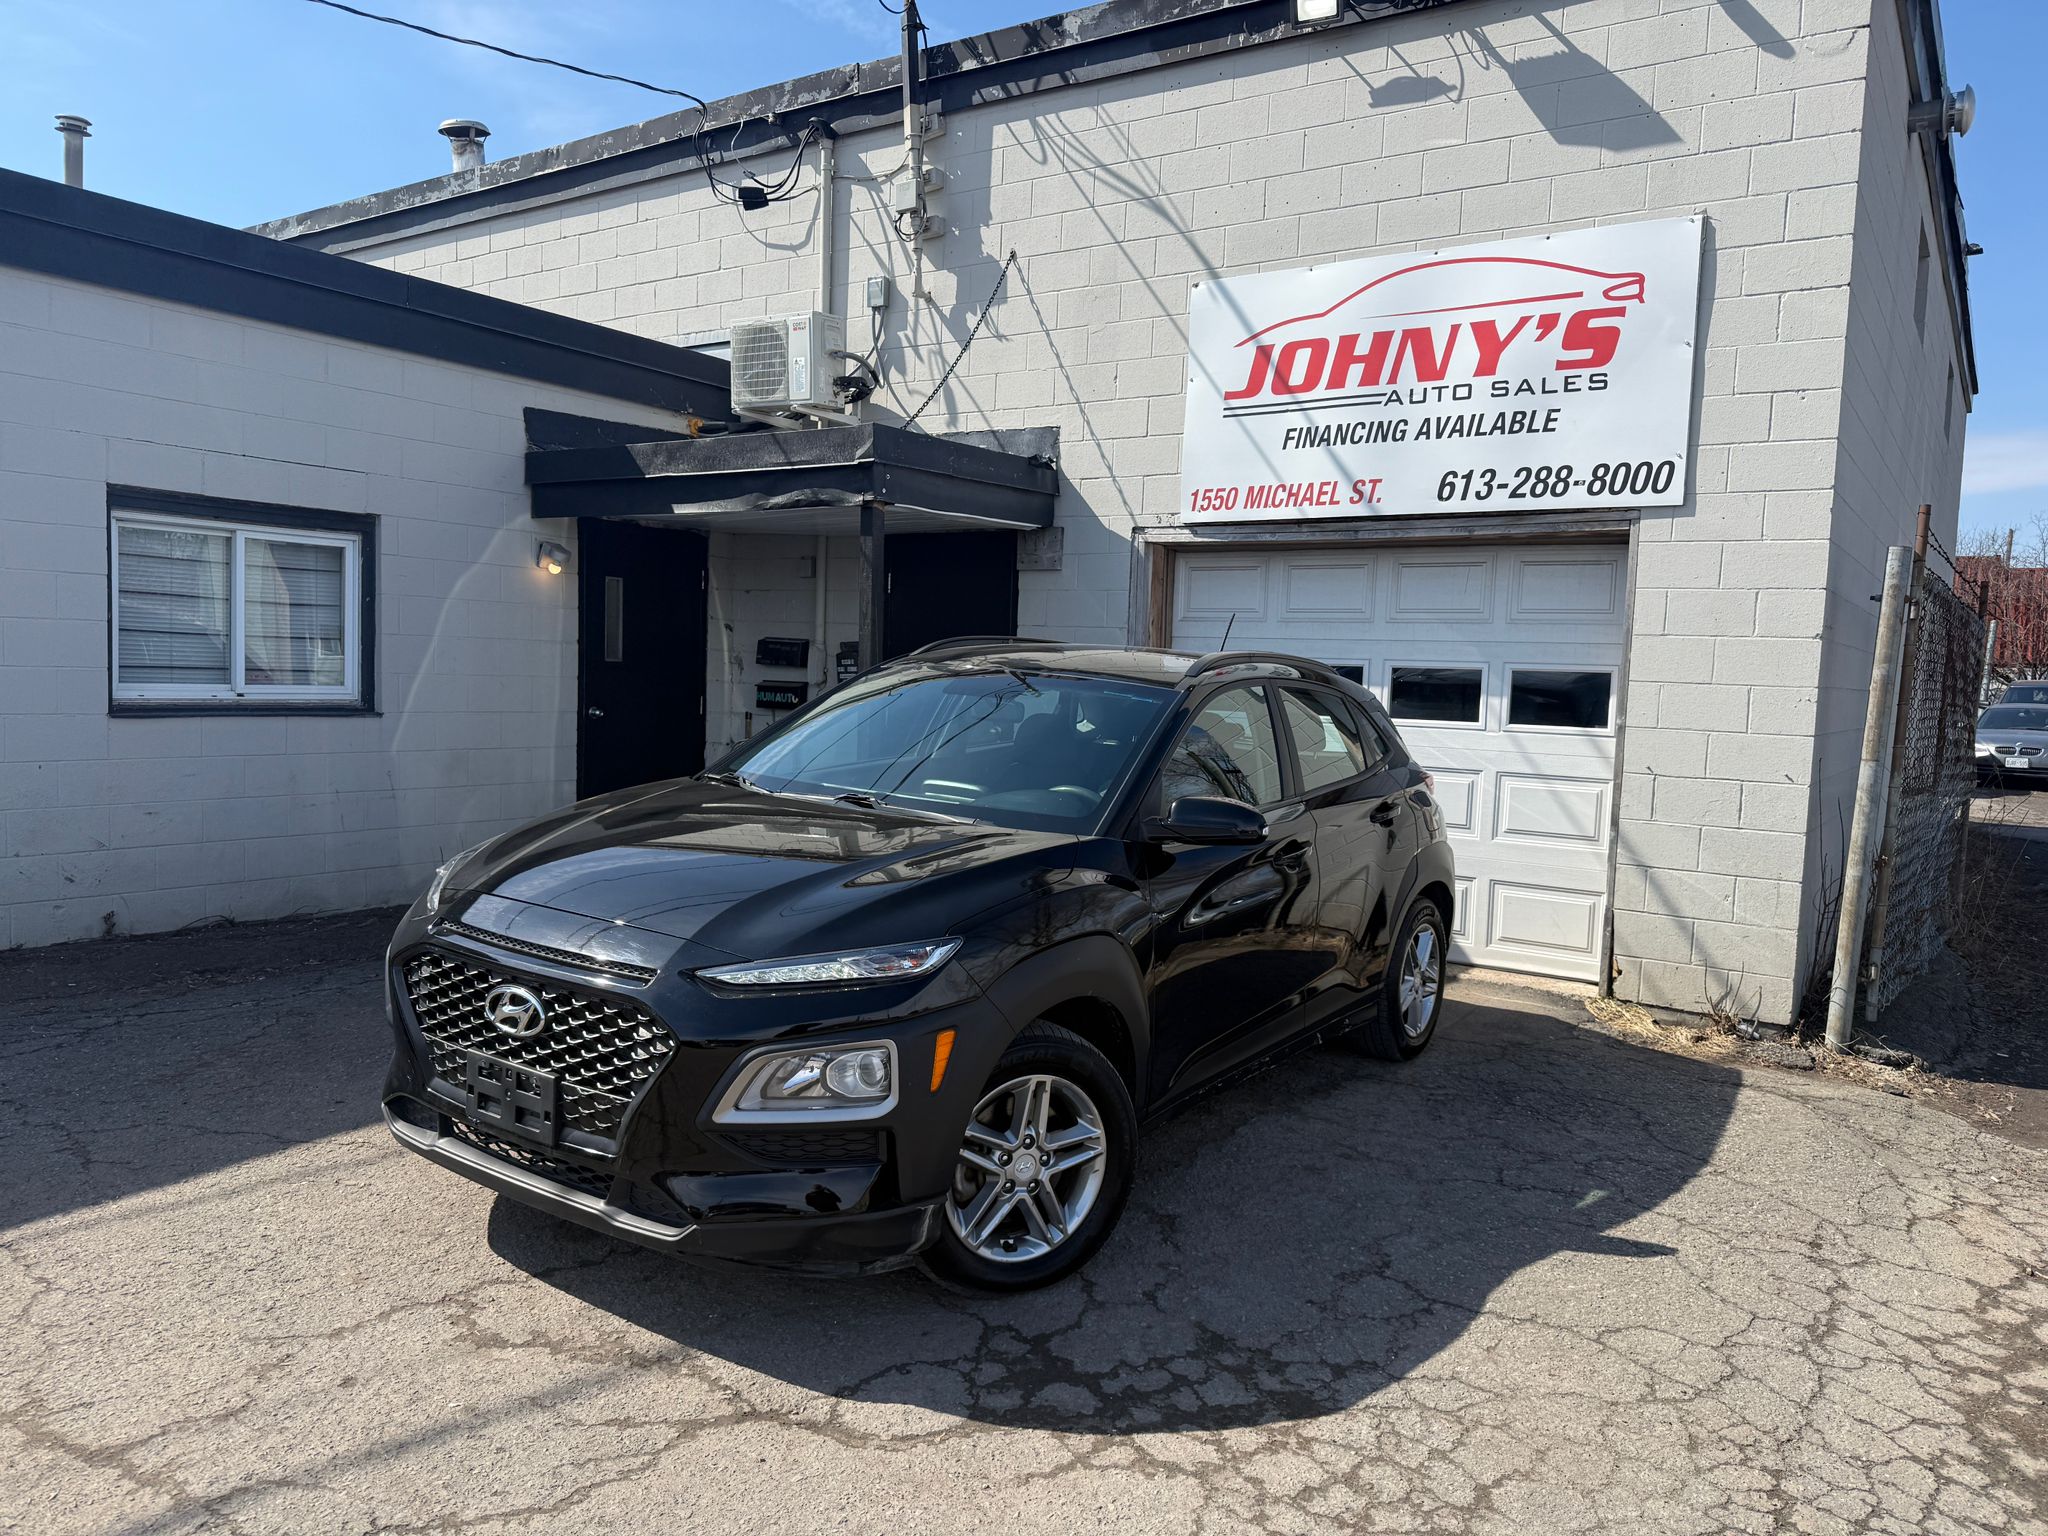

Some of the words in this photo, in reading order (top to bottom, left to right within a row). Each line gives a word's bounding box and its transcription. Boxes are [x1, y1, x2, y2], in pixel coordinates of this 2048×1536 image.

[1224, 306, 1626, 400] JOHNY'S
[1384, 383, 1473, 407] AUTO
[1490, 372, 1608, 398] SALES
[1282, 418, 1409, 450] FINANCING
[1413, 408, 1561, 441] AVAILABLE
[1190, 486, 1239, 512] 1550
[1243, 480, 1341, 509] MICHAEL
[1349, 478, 1383, 505] ST.
[1436, 460, 1676, 502] 613-288-8000
